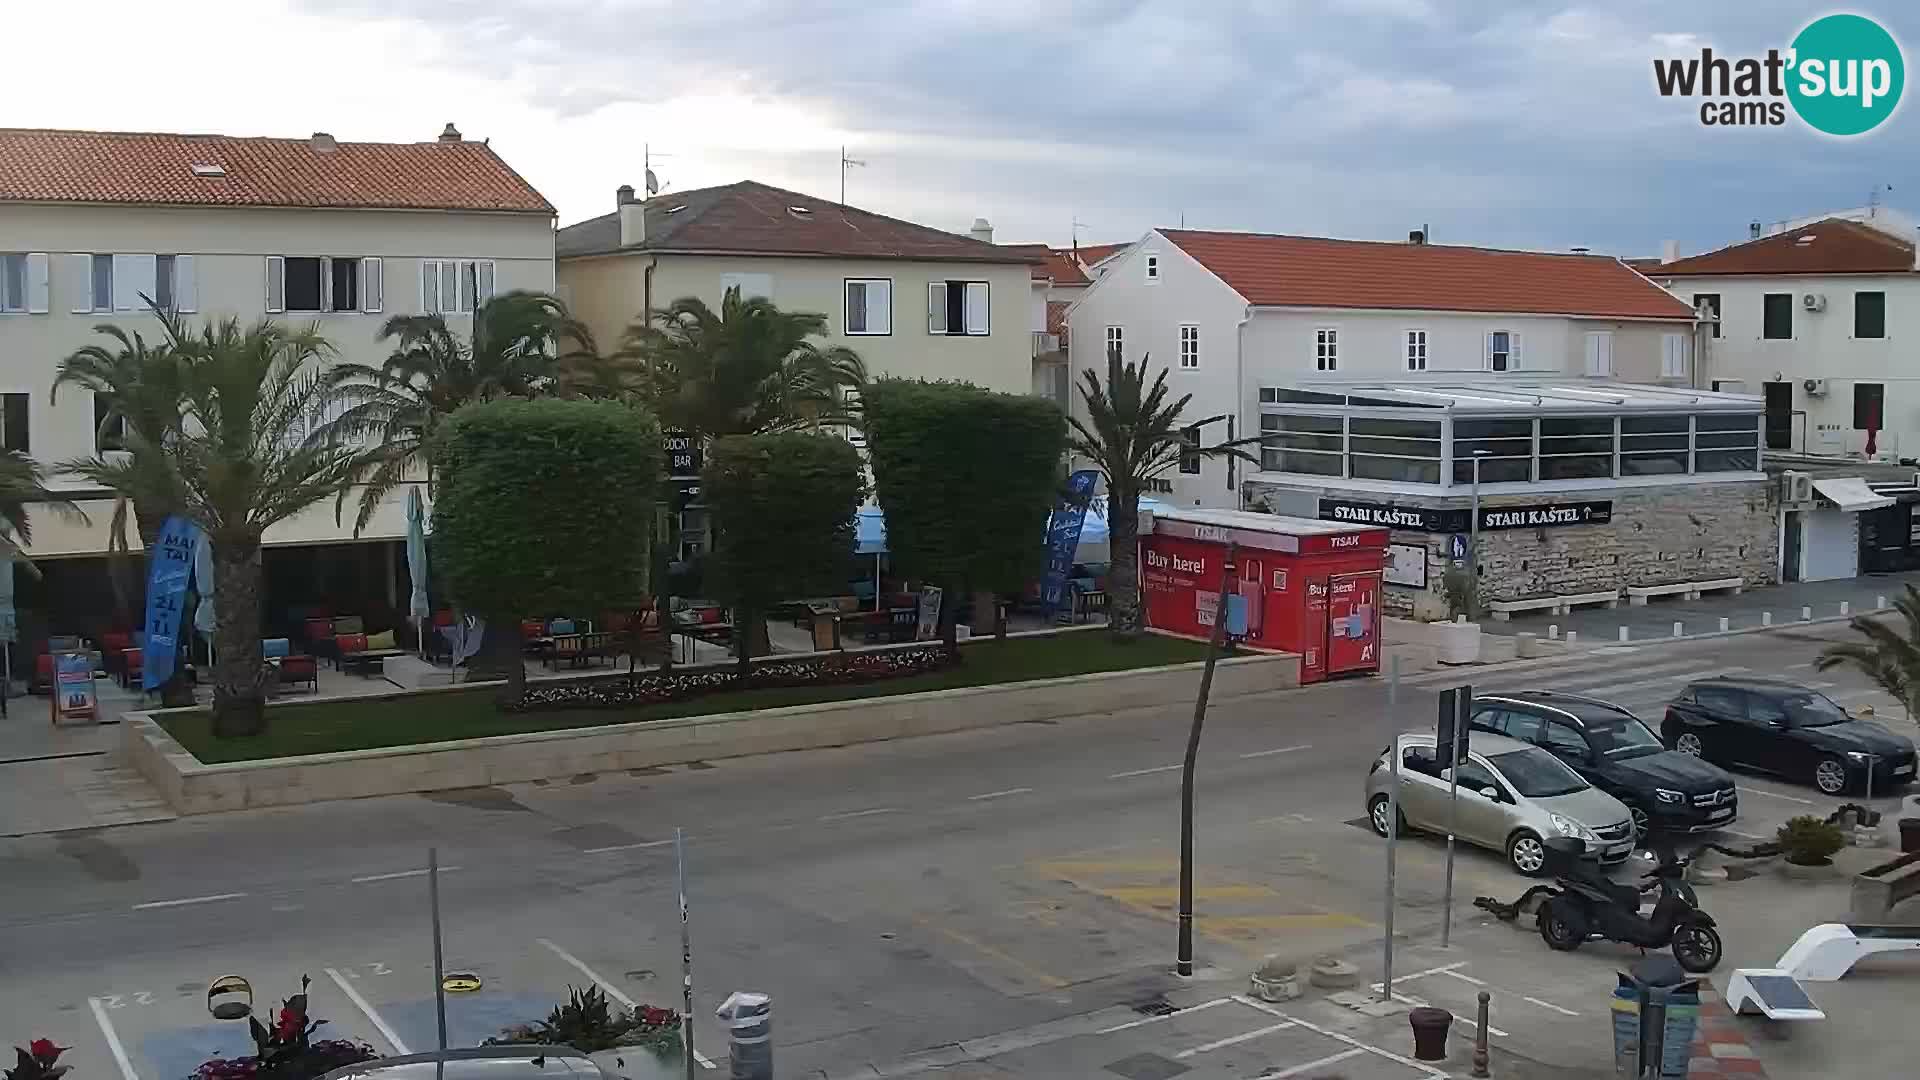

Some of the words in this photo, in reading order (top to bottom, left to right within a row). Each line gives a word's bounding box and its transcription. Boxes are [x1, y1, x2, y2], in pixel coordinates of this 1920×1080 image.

[674, 455, 691, 468] BAR
[1335, 506, 1370, 521] STARI
[1373, 508, 1424, 527] KAŠTEL
[1486, 512, 1525, 527] STARI
[1528, 507, 1580, 524] KAŠTEL
[164, 533, 194, 549] MAI
[1331, 535, 1359, 548] TISAK
[165, 547, 189, 563] TAI
[1147, 550, 1169, 569] Buy
[1173, 554, 1206, 575] here!
[1309, 584, 1328, 597] Buy
[1333, 580, 1356, 594] here!
